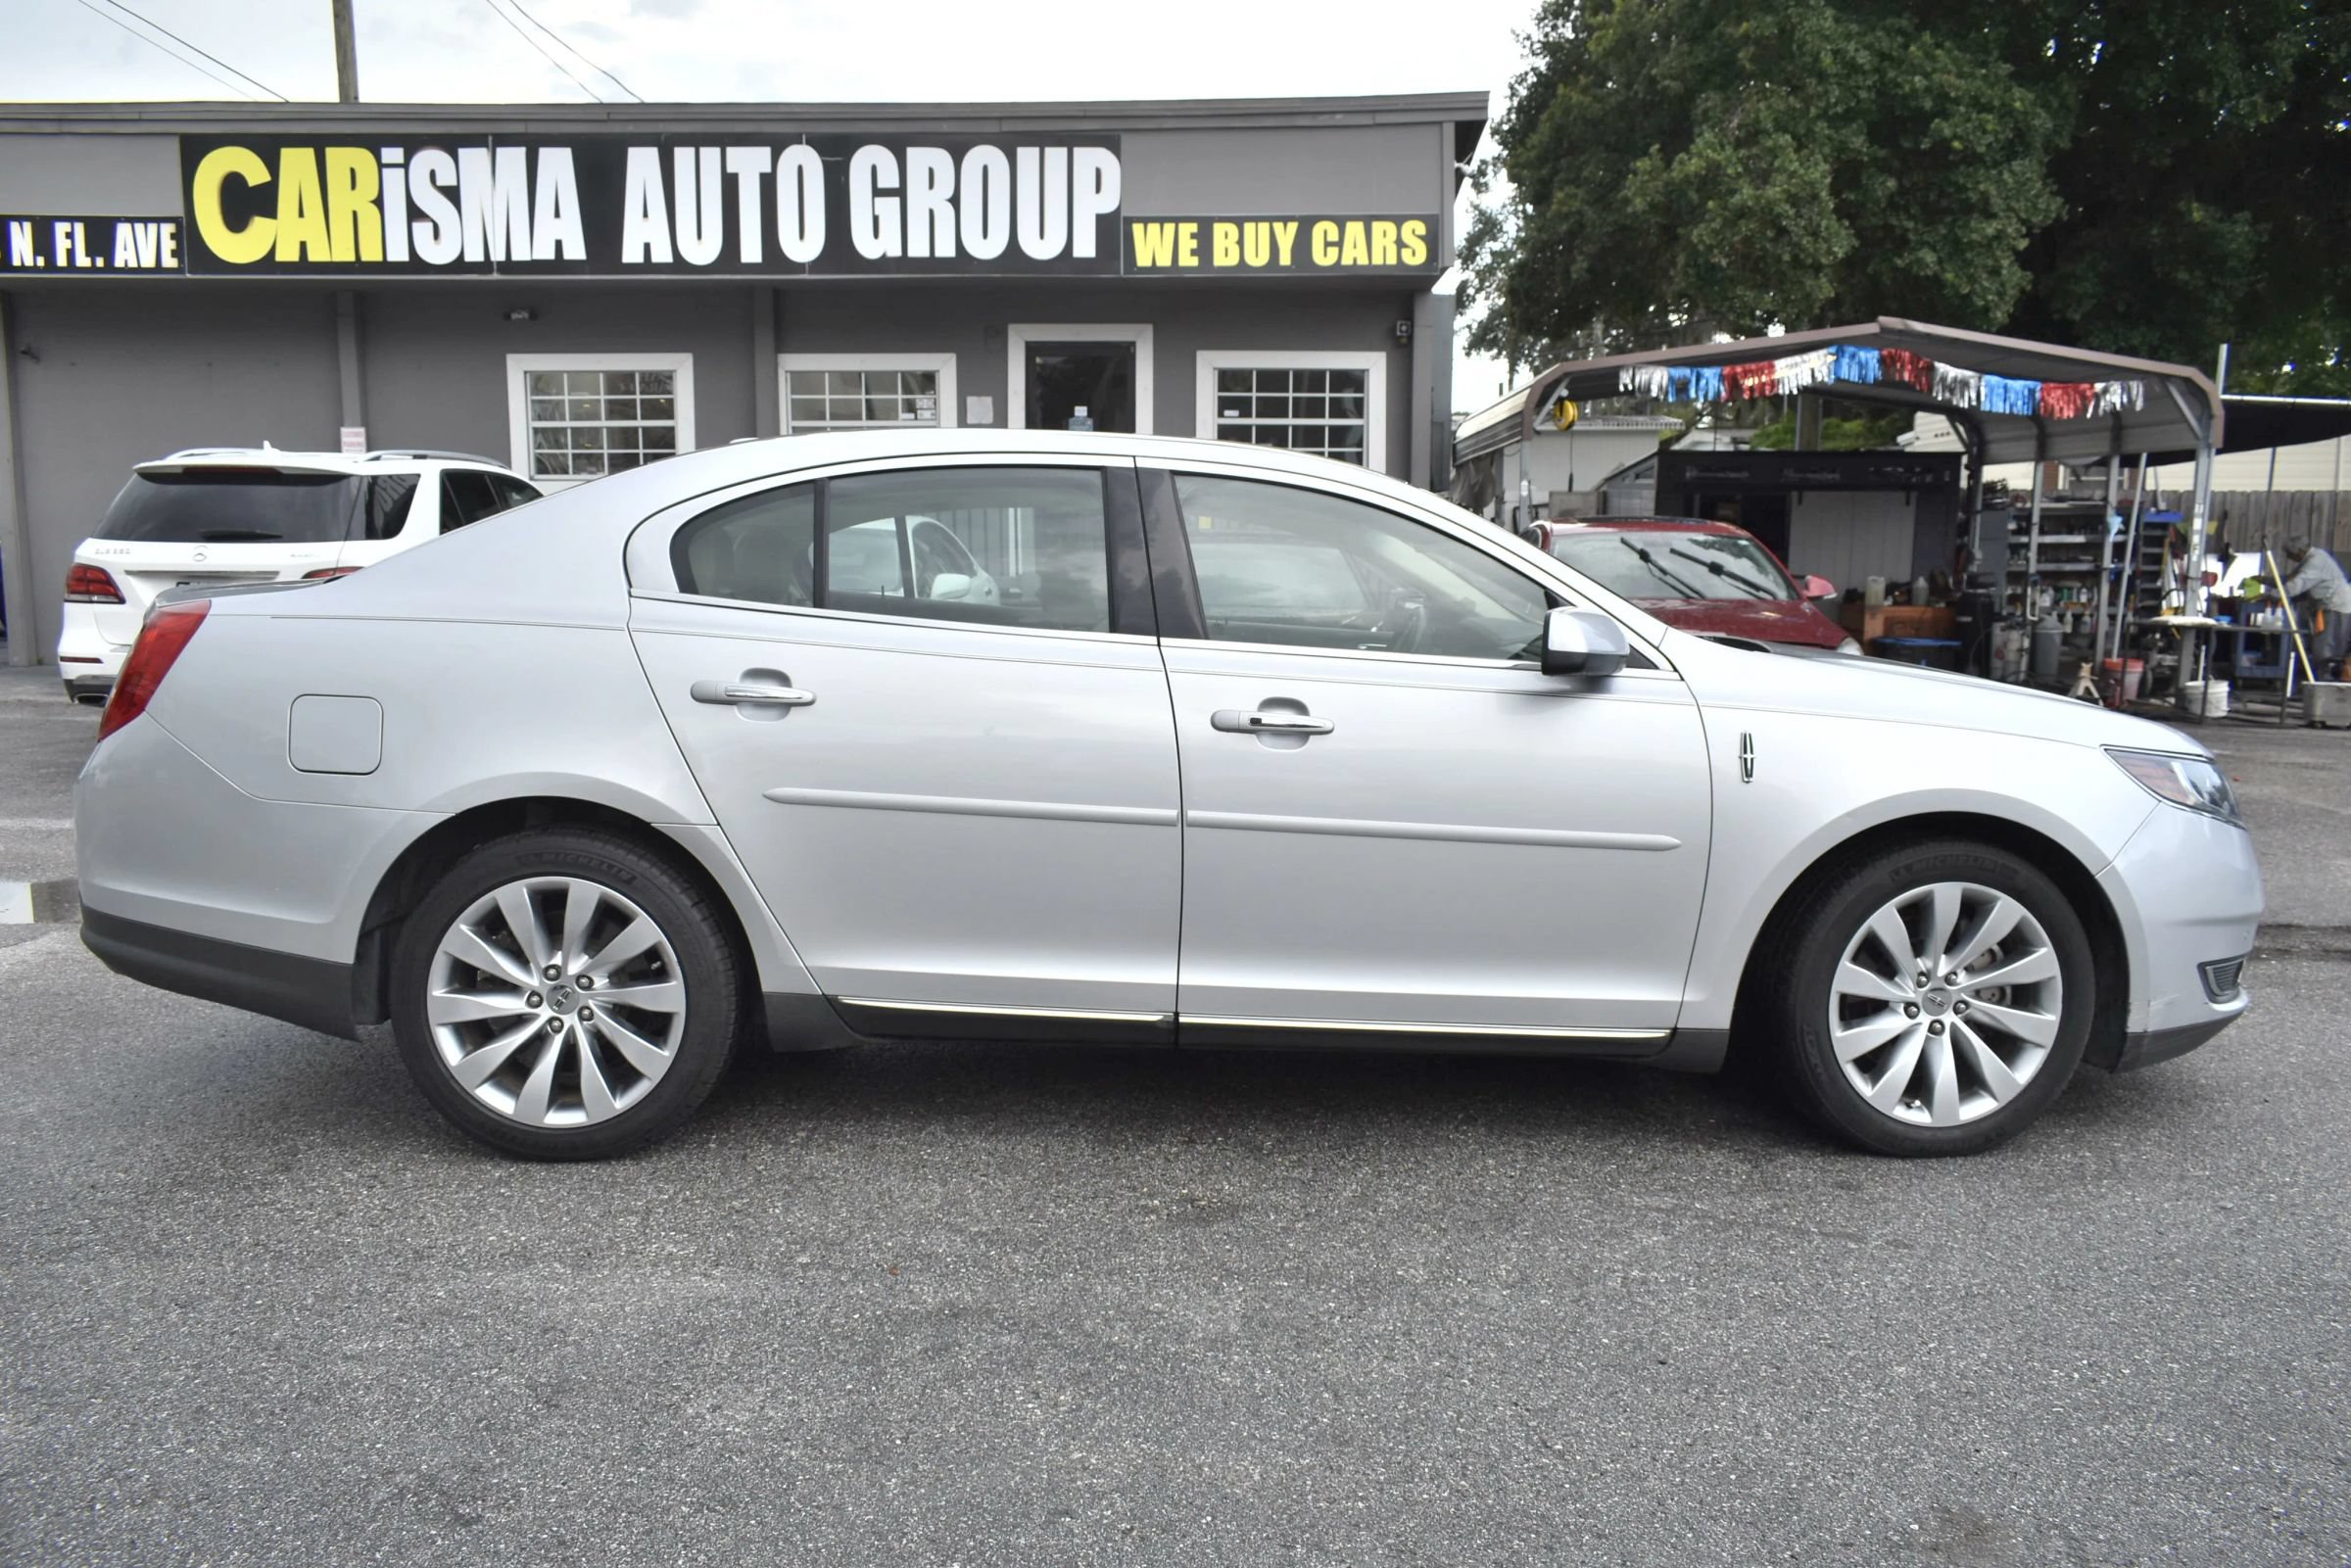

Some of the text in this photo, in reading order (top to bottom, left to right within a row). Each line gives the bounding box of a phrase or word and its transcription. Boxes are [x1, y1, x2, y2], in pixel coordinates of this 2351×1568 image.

[621, 144, 826, 266] AUTO
[848, 144, 1121, 261] GROUP
[9, 221, 179, 268] N. FL. AVE
[1131, 219, 1427, 267] WE BUY CARS
